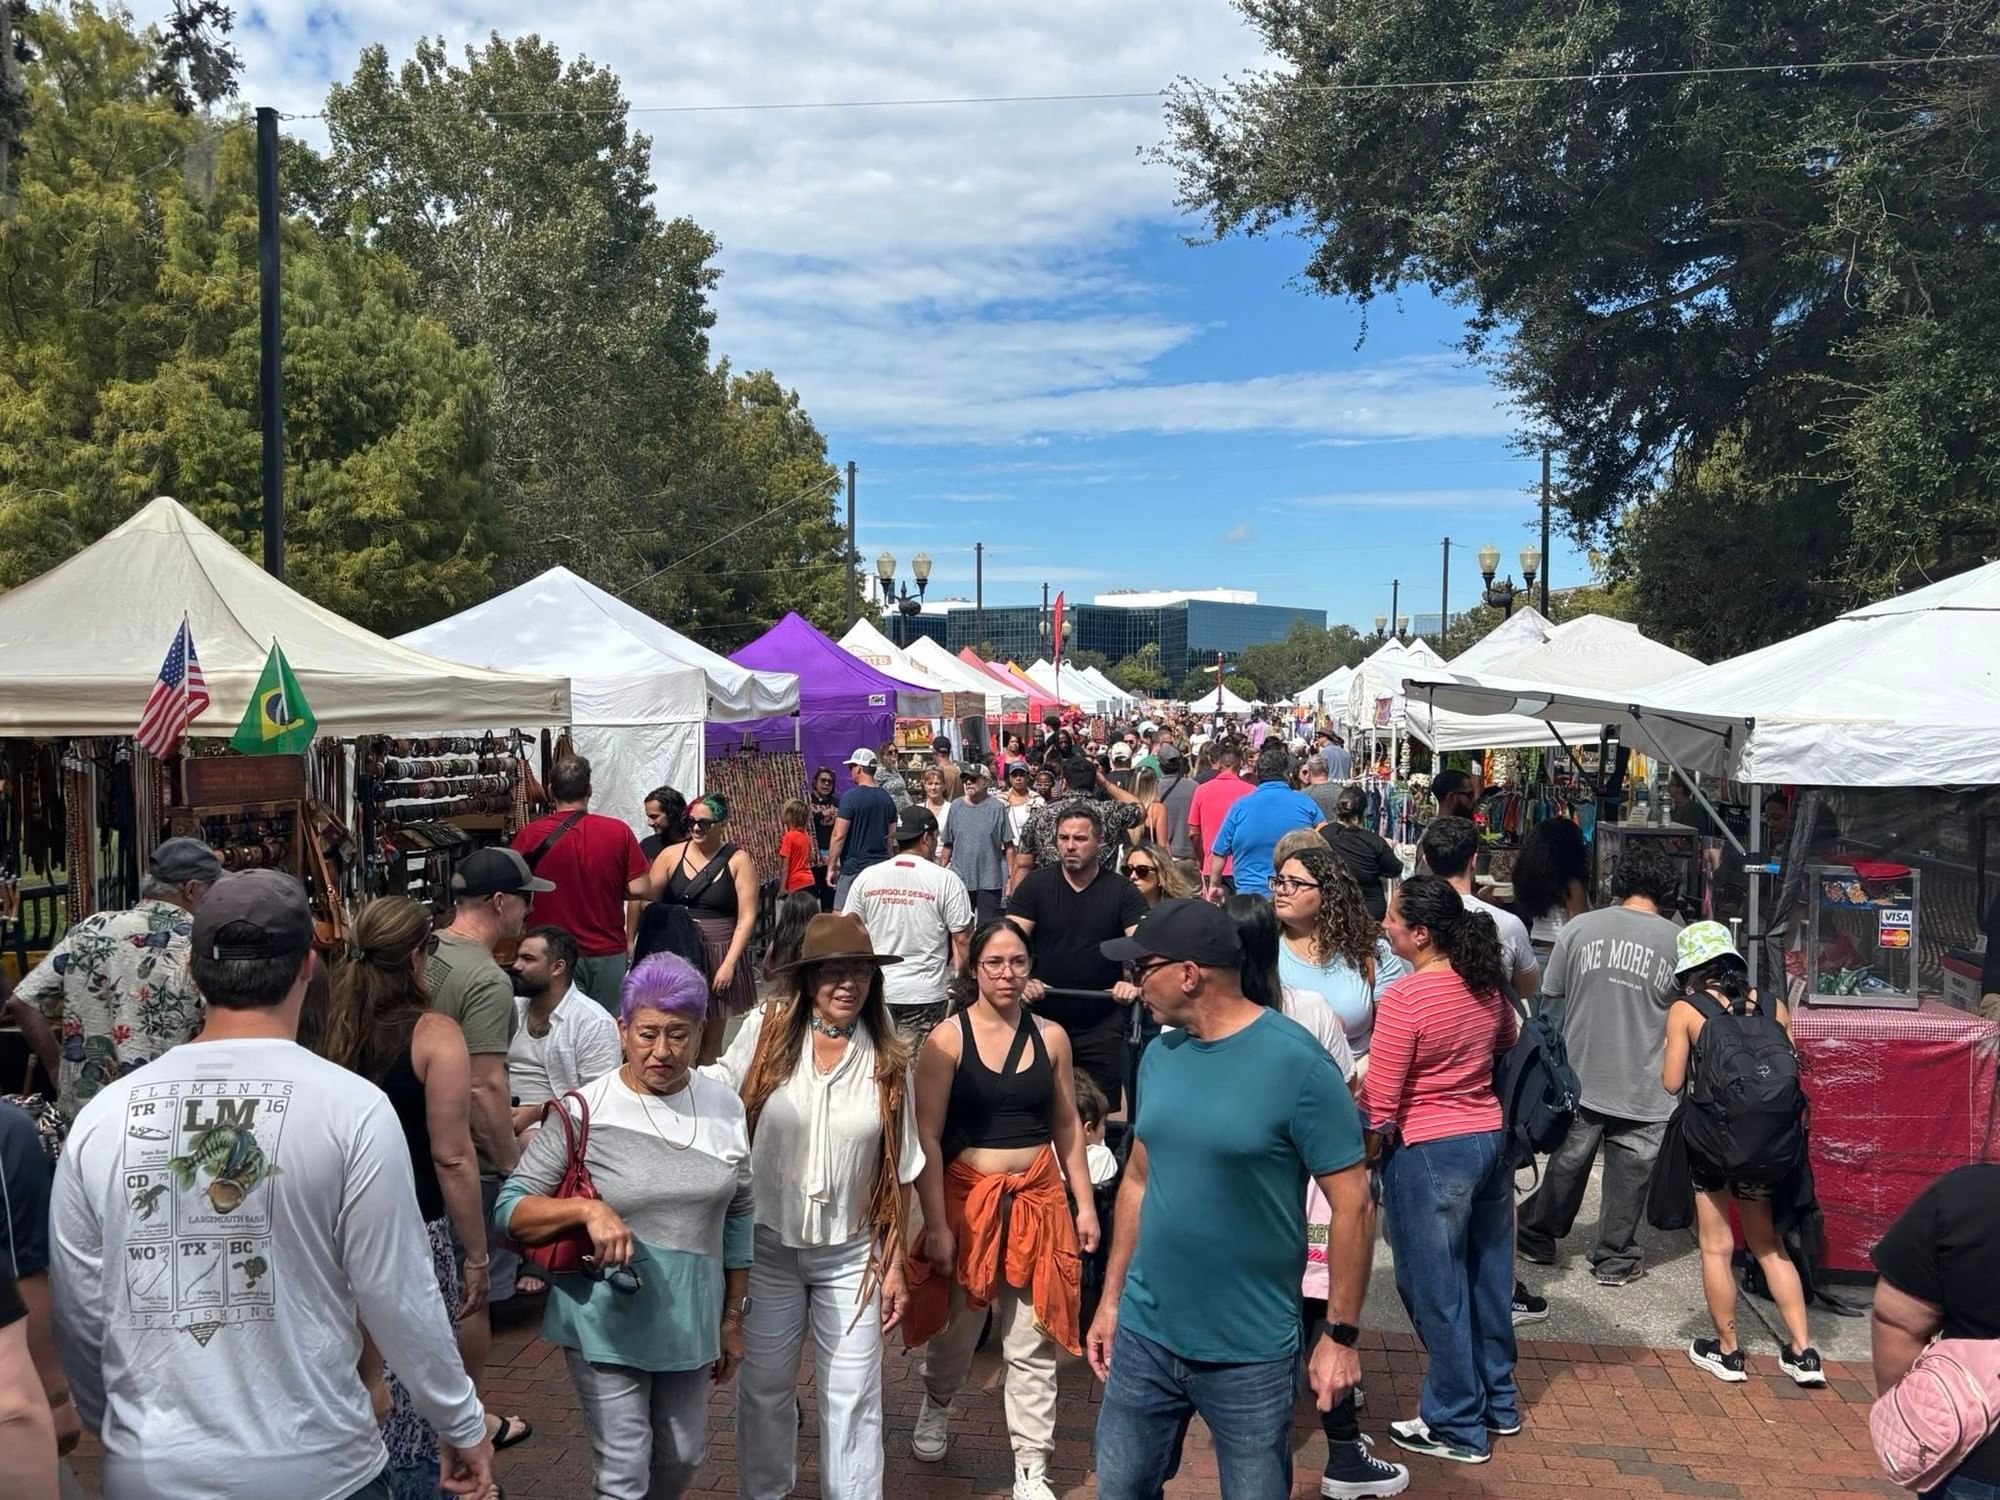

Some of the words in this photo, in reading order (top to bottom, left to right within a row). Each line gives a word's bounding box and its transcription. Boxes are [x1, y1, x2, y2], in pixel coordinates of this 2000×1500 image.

[908, 890, 935, 901] DESIGN
[1885, 912, 1909, 921] VISA
[1581, 939, 1604, 975] ONE
[1607, 939, 1654, 979] MORE
[130, 1084, 293, 1101] ELEMENTS
[131, 1102, 156, 1117] TR
[265, 1101, 285, 1113] 16
[182, 1099, 260, 1132] LM
[127, 1175, 149, 1188] CD
[188, 1215, 244, 1225] LARGEMOUTH
[245, 1214, 265, 1224] BASS
[128, 1247, 156, 1260] WO
[180, 1242, 207, 1256] TX
[230, 1241, 253, 1254] BC
[130, 1315, 153, 1326] OF
[172, 1307, 276, 1325] FISHING
